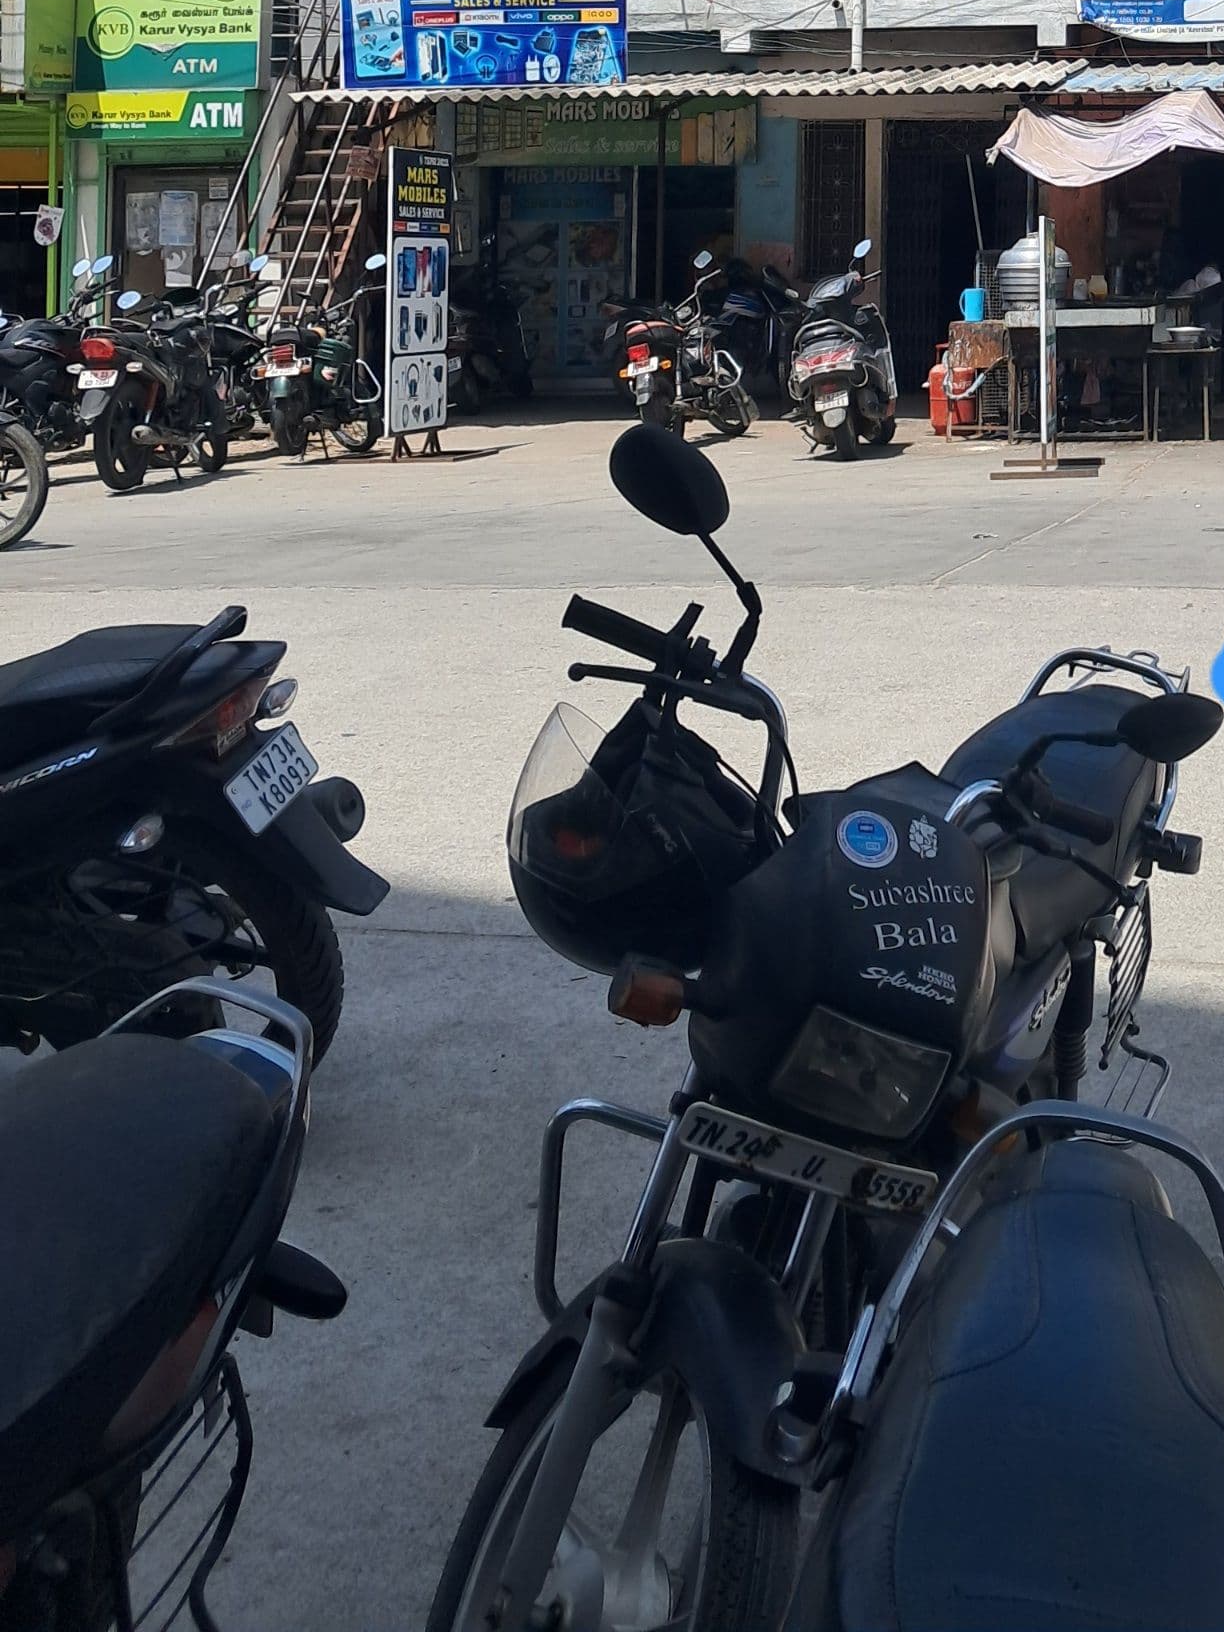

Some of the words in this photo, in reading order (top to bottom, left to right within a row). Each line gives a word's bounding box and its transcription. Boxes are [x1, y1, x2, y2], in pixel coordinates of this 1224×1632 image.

[510, 12, 533, 20] vivo
[546, 13, 575, 22] oppo
[98, 23, 130, 36] KVB
[140, 24, 176, 36] Karur
[178, 23, 216, 37] Vysya
[219, 22, 253, 34] Bank
[172, 58, 218, 73] ATM
[91, 111, 117, 120] Karur
[119, 111, 147, 121] Vysya
[149, 109, 172, 119] Bank
[189, 102, 243, 128] ATM
[547, 100, 597, 123] MARS
[603, 100, 681, 120] MOBIS
[407, 166, 439, 185] MARS
[503, 169, 548, 184] MARS
[552, 167, 621, 183] MOBILES
[398, 185, 447, 204] MOBILES
[398, 205, 416, 218] SALES
[242, 735, 297, 791] TN73A
[258, 757, 311, 816] K8093
[873, 917, 959, 951] Bala
[918, 971, 957, 993] HONDA
[923, 964, 955, 982] HERO
